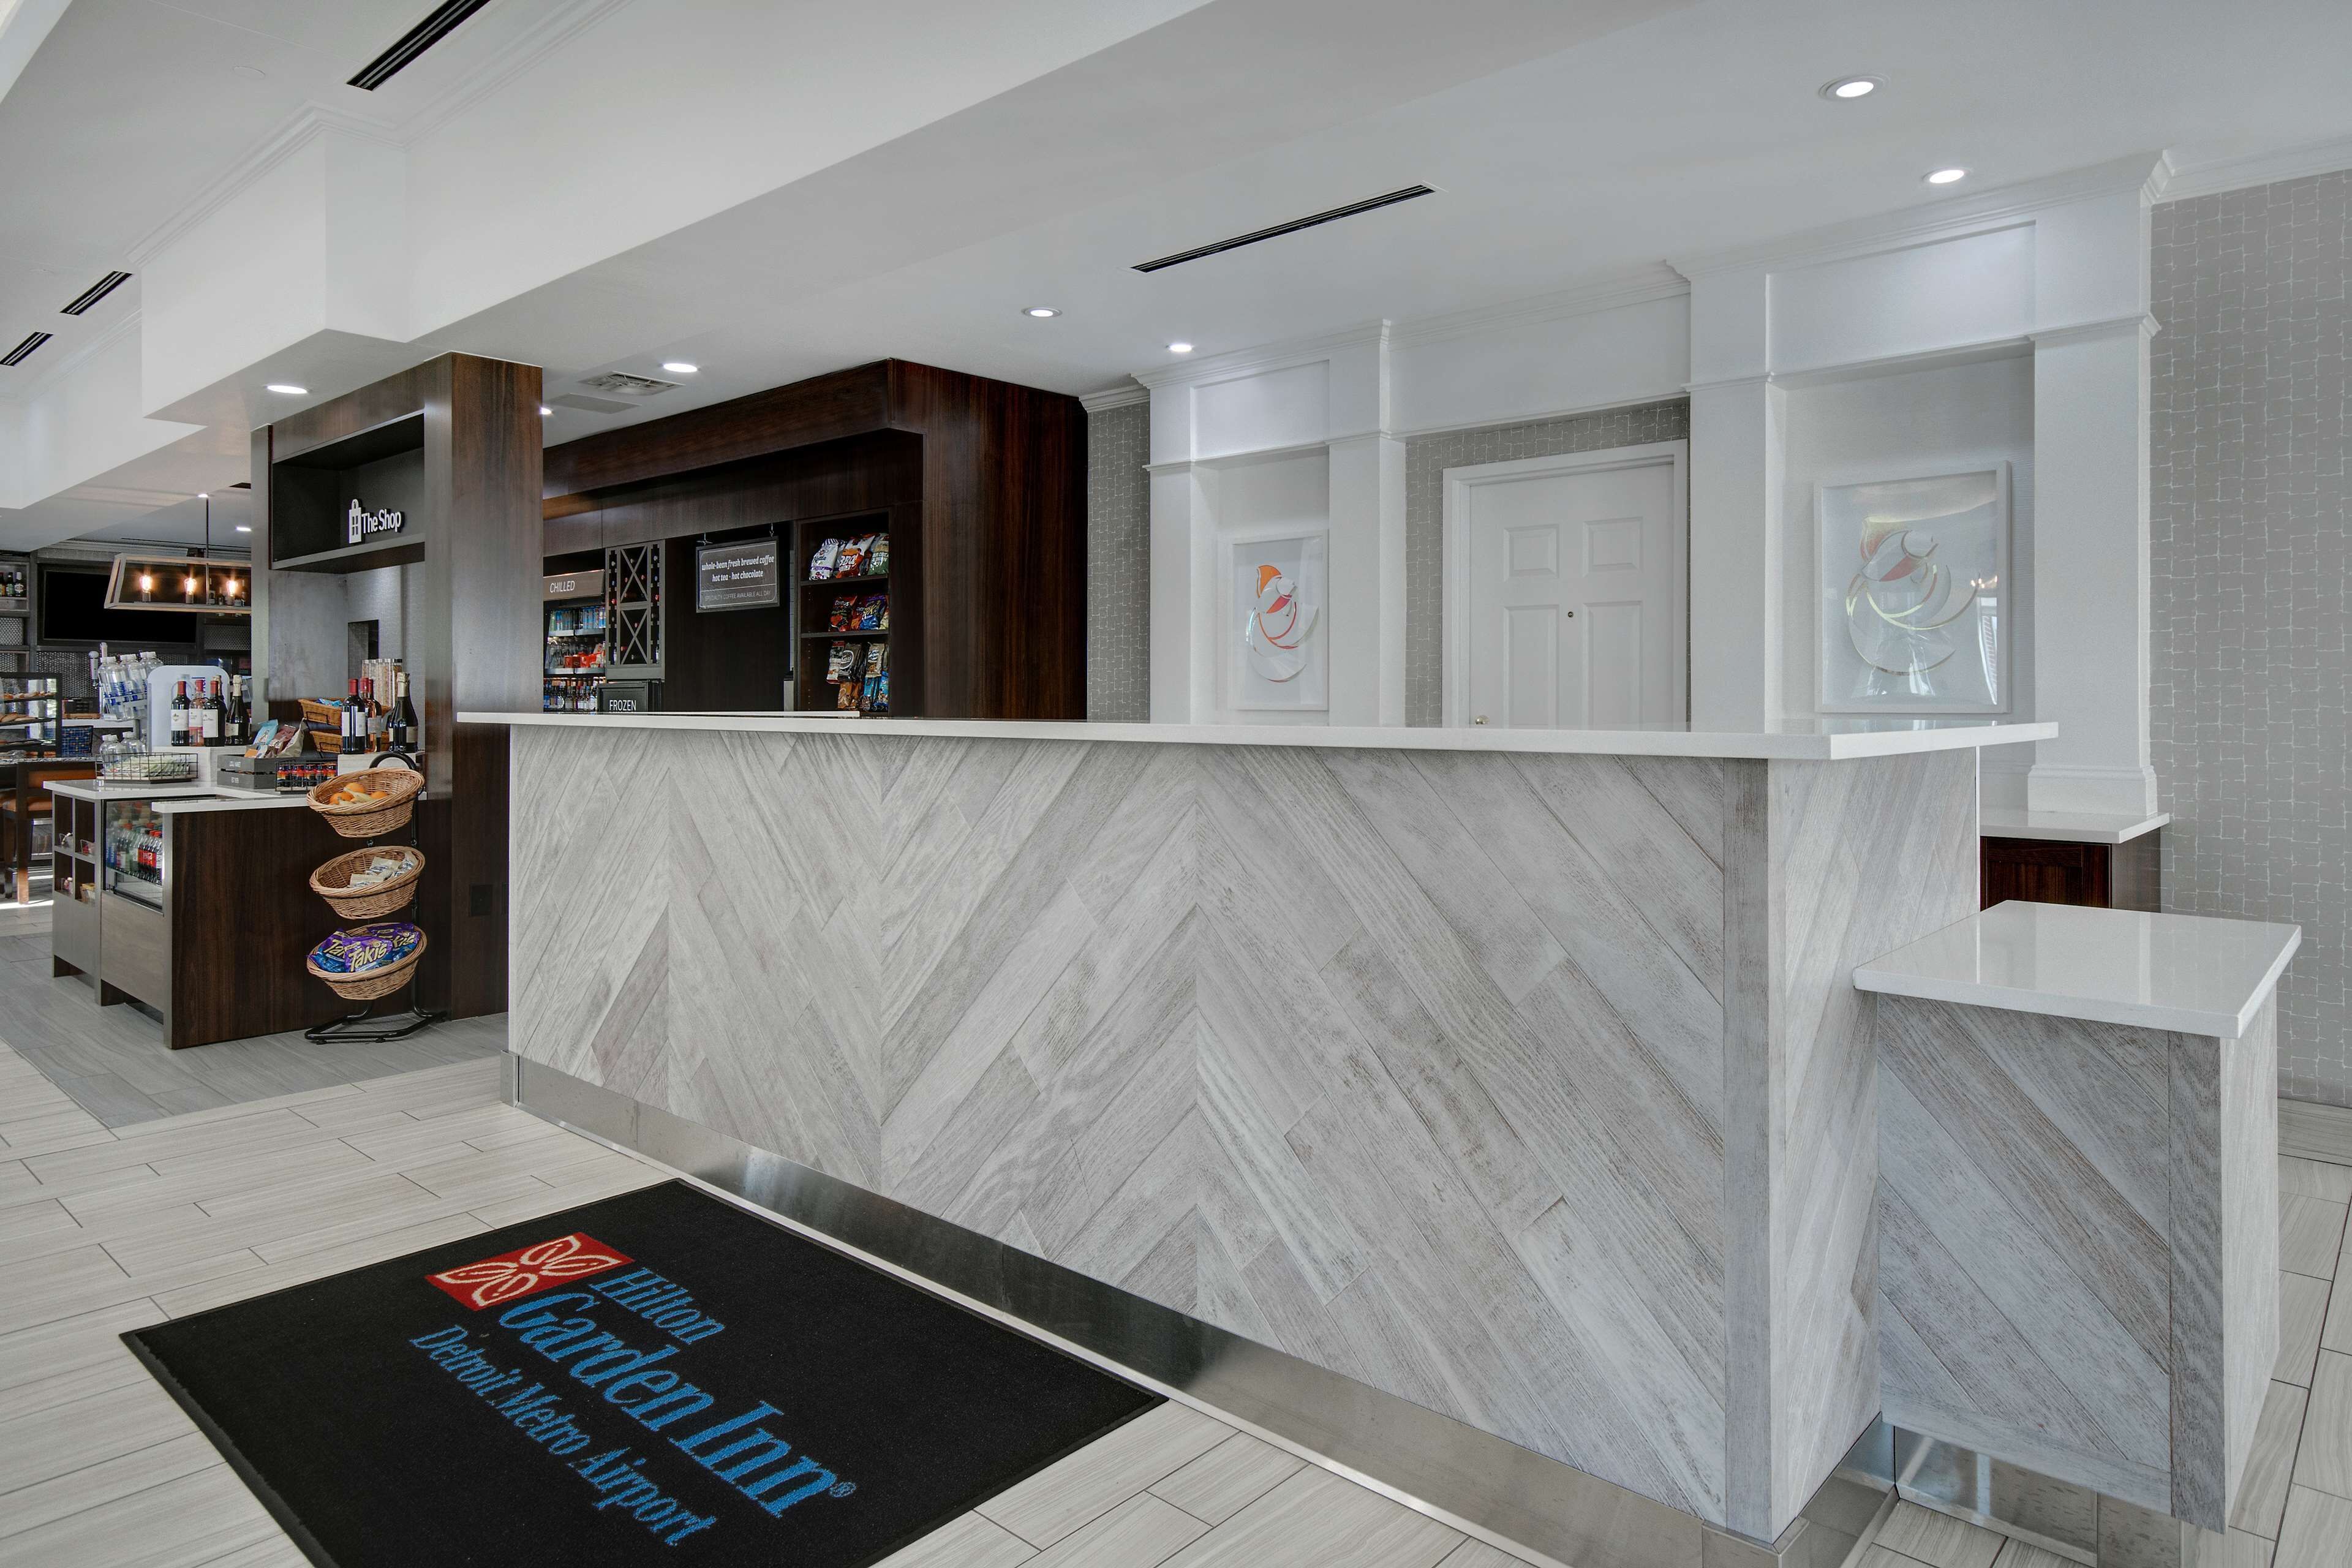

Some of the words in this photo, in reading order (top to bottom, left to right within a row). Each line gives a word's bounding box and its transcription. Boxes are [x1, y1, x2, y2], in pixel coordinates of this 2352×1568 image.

[361, 512, 379, 533] The
[379, 508, 402, 532] Shop
[701, 561, 728, 571] whole-bean
[727, 558, 741, 570] fresh
[741, 556, 759, 567] brewed
[760, 555, 775, 565] coffee
[740, 570, 764, 579] chocolate
[550, 580, 575, 593] CHILLED
[609, 699, 636, 711] FROZEN
[348, 941, 388, 973] Takis
[588, 1267, 726, 1345] Hilton
[499, 1292, 714, 1432] Garden
[409, 1324, 522, 1396] Detroit
[485, 1382, 590, 1455] Metro
[567, 1447, 717, 1547] Airport
